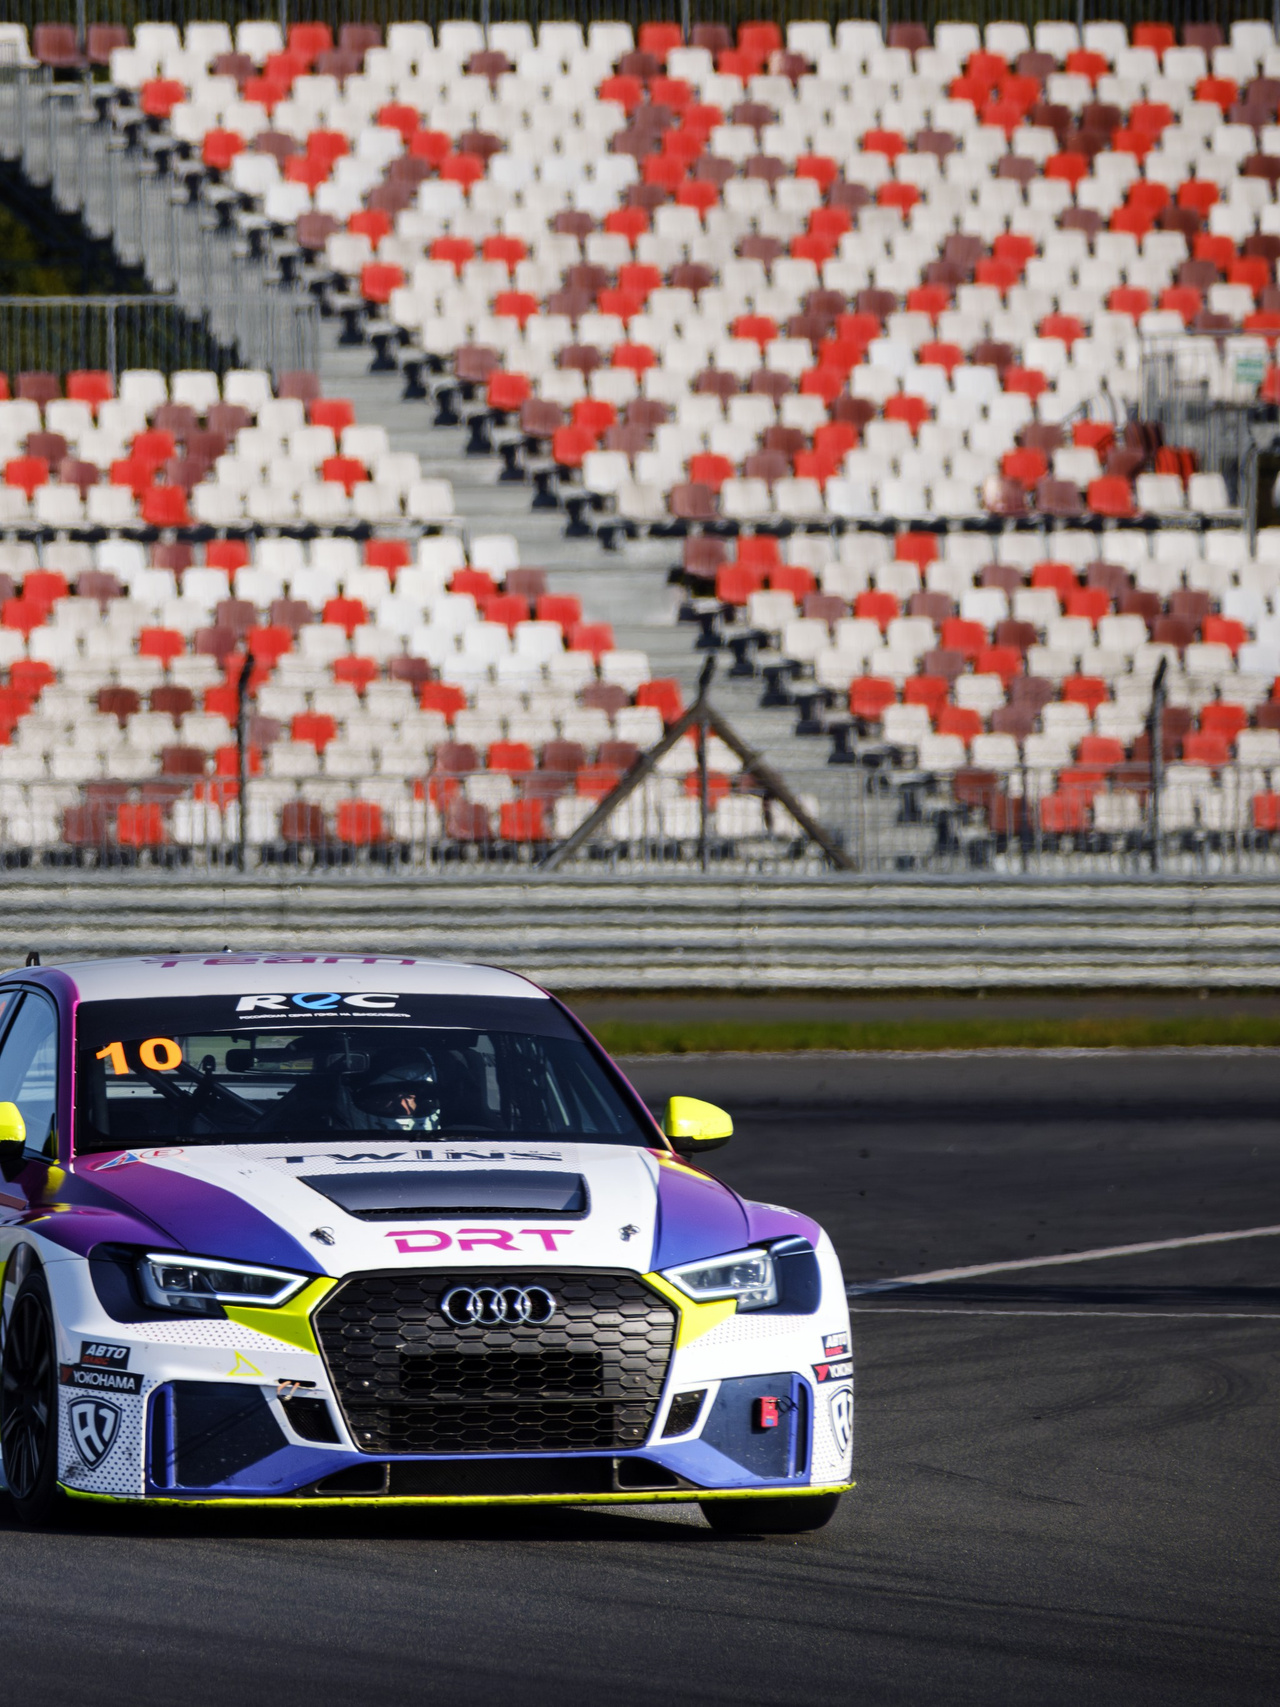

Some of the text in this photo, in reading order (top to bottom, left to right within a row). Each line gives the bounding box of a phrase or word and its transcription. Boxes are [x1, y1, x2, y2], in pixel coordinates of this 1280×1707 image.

[95, 1037, 184, 1076] 10
[265, 1149, 564, 1164] TWINS
[384, 1228, 575, 1253] DRT
[73, 1370, 136, 1390] YOKOHAMA
